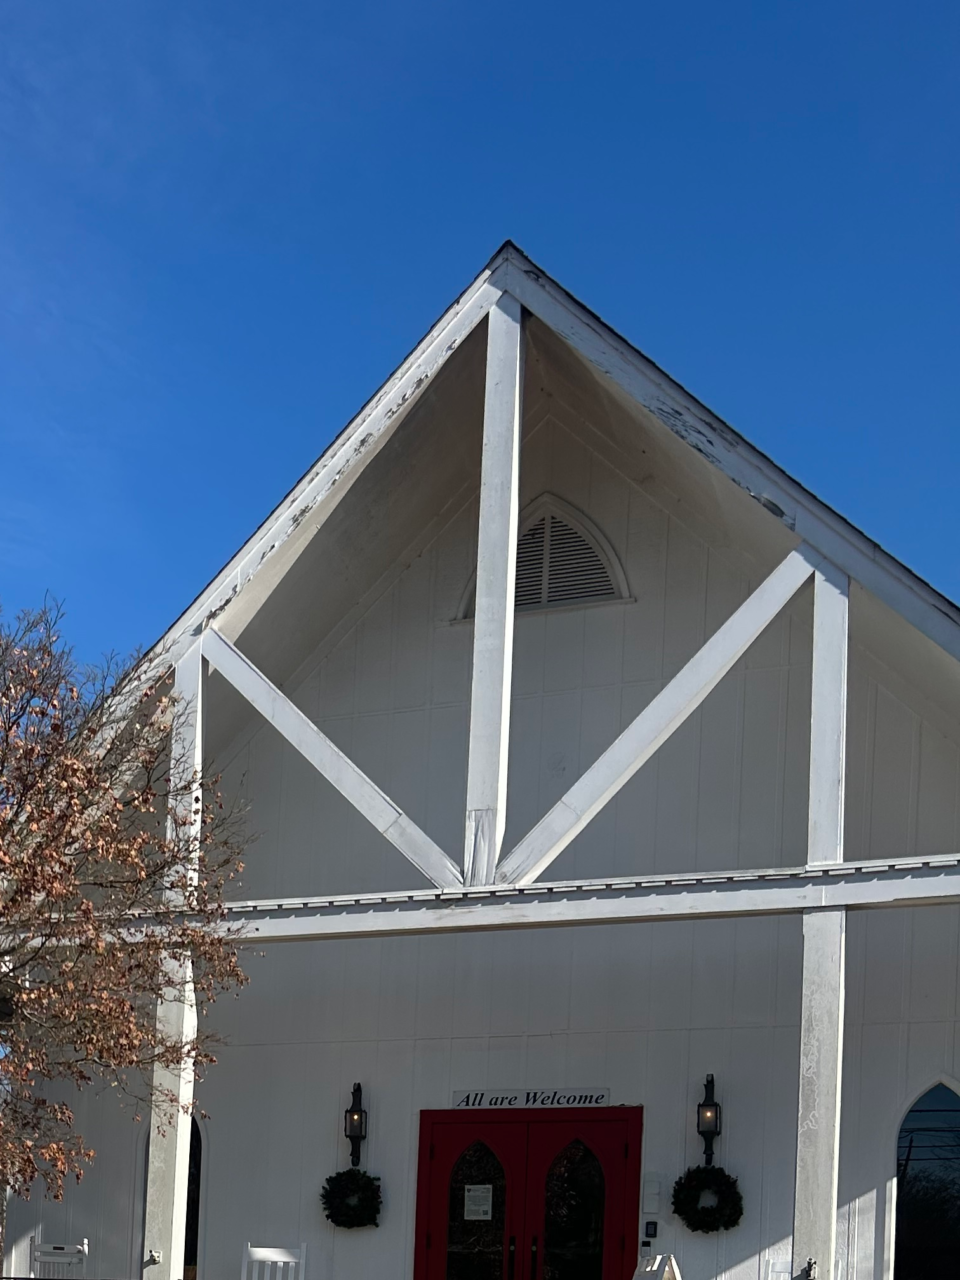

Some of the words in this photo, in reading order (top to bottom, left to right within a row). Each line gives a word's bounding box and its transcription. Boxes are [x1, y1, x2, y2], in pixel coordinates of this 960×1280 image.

[456, 1092, 485, 1107] All
[488, 1095, 518, 1106] are
[524, 1091, 605, 1106] Welcome
